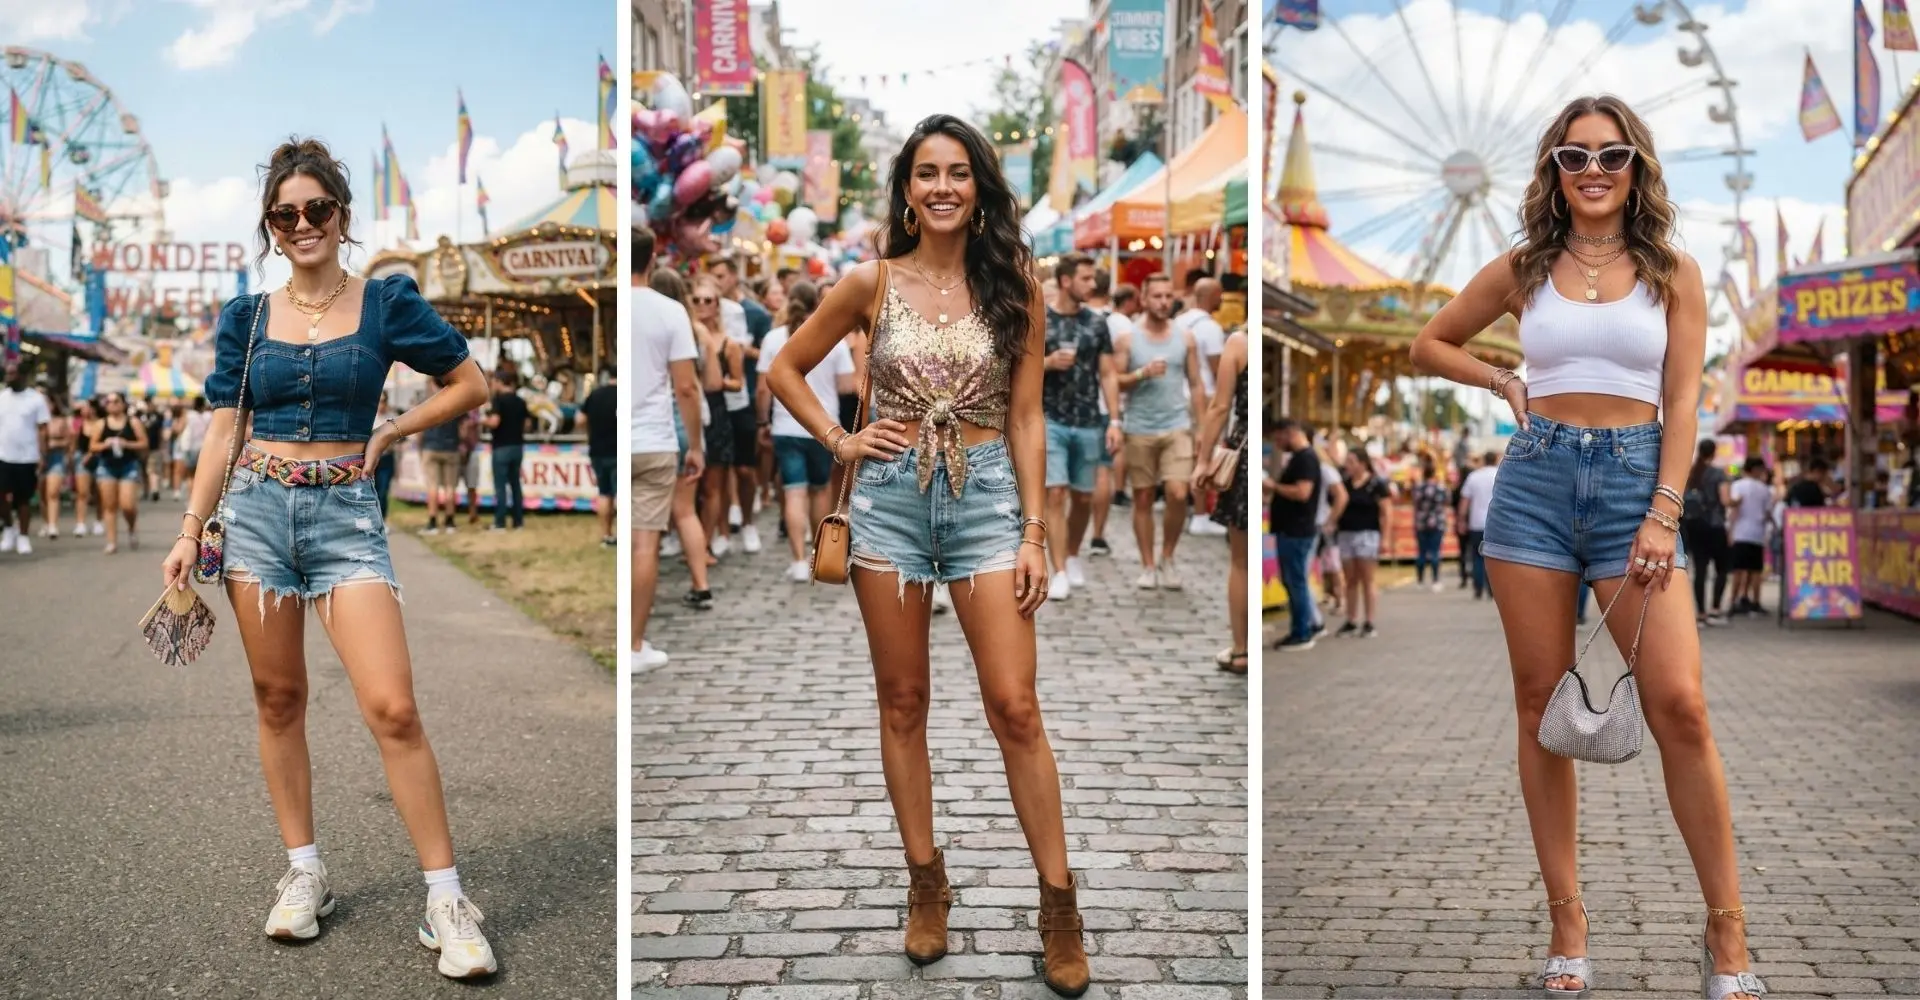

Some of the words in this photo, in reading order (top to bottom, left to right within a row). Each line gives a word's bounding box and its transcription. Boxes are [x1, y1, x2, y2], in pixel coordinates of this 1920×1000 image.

[1113, 28, 1162, 51] VIBES
[92, 242, 246, 272] WONDER
[510, 247, 598, 271] CARNIVAL
[1796, 278, 1907, 322] PRIZES
[1795, 531, 1848, 557] FUN
[1794, 559, 1853, 586] FAIR
